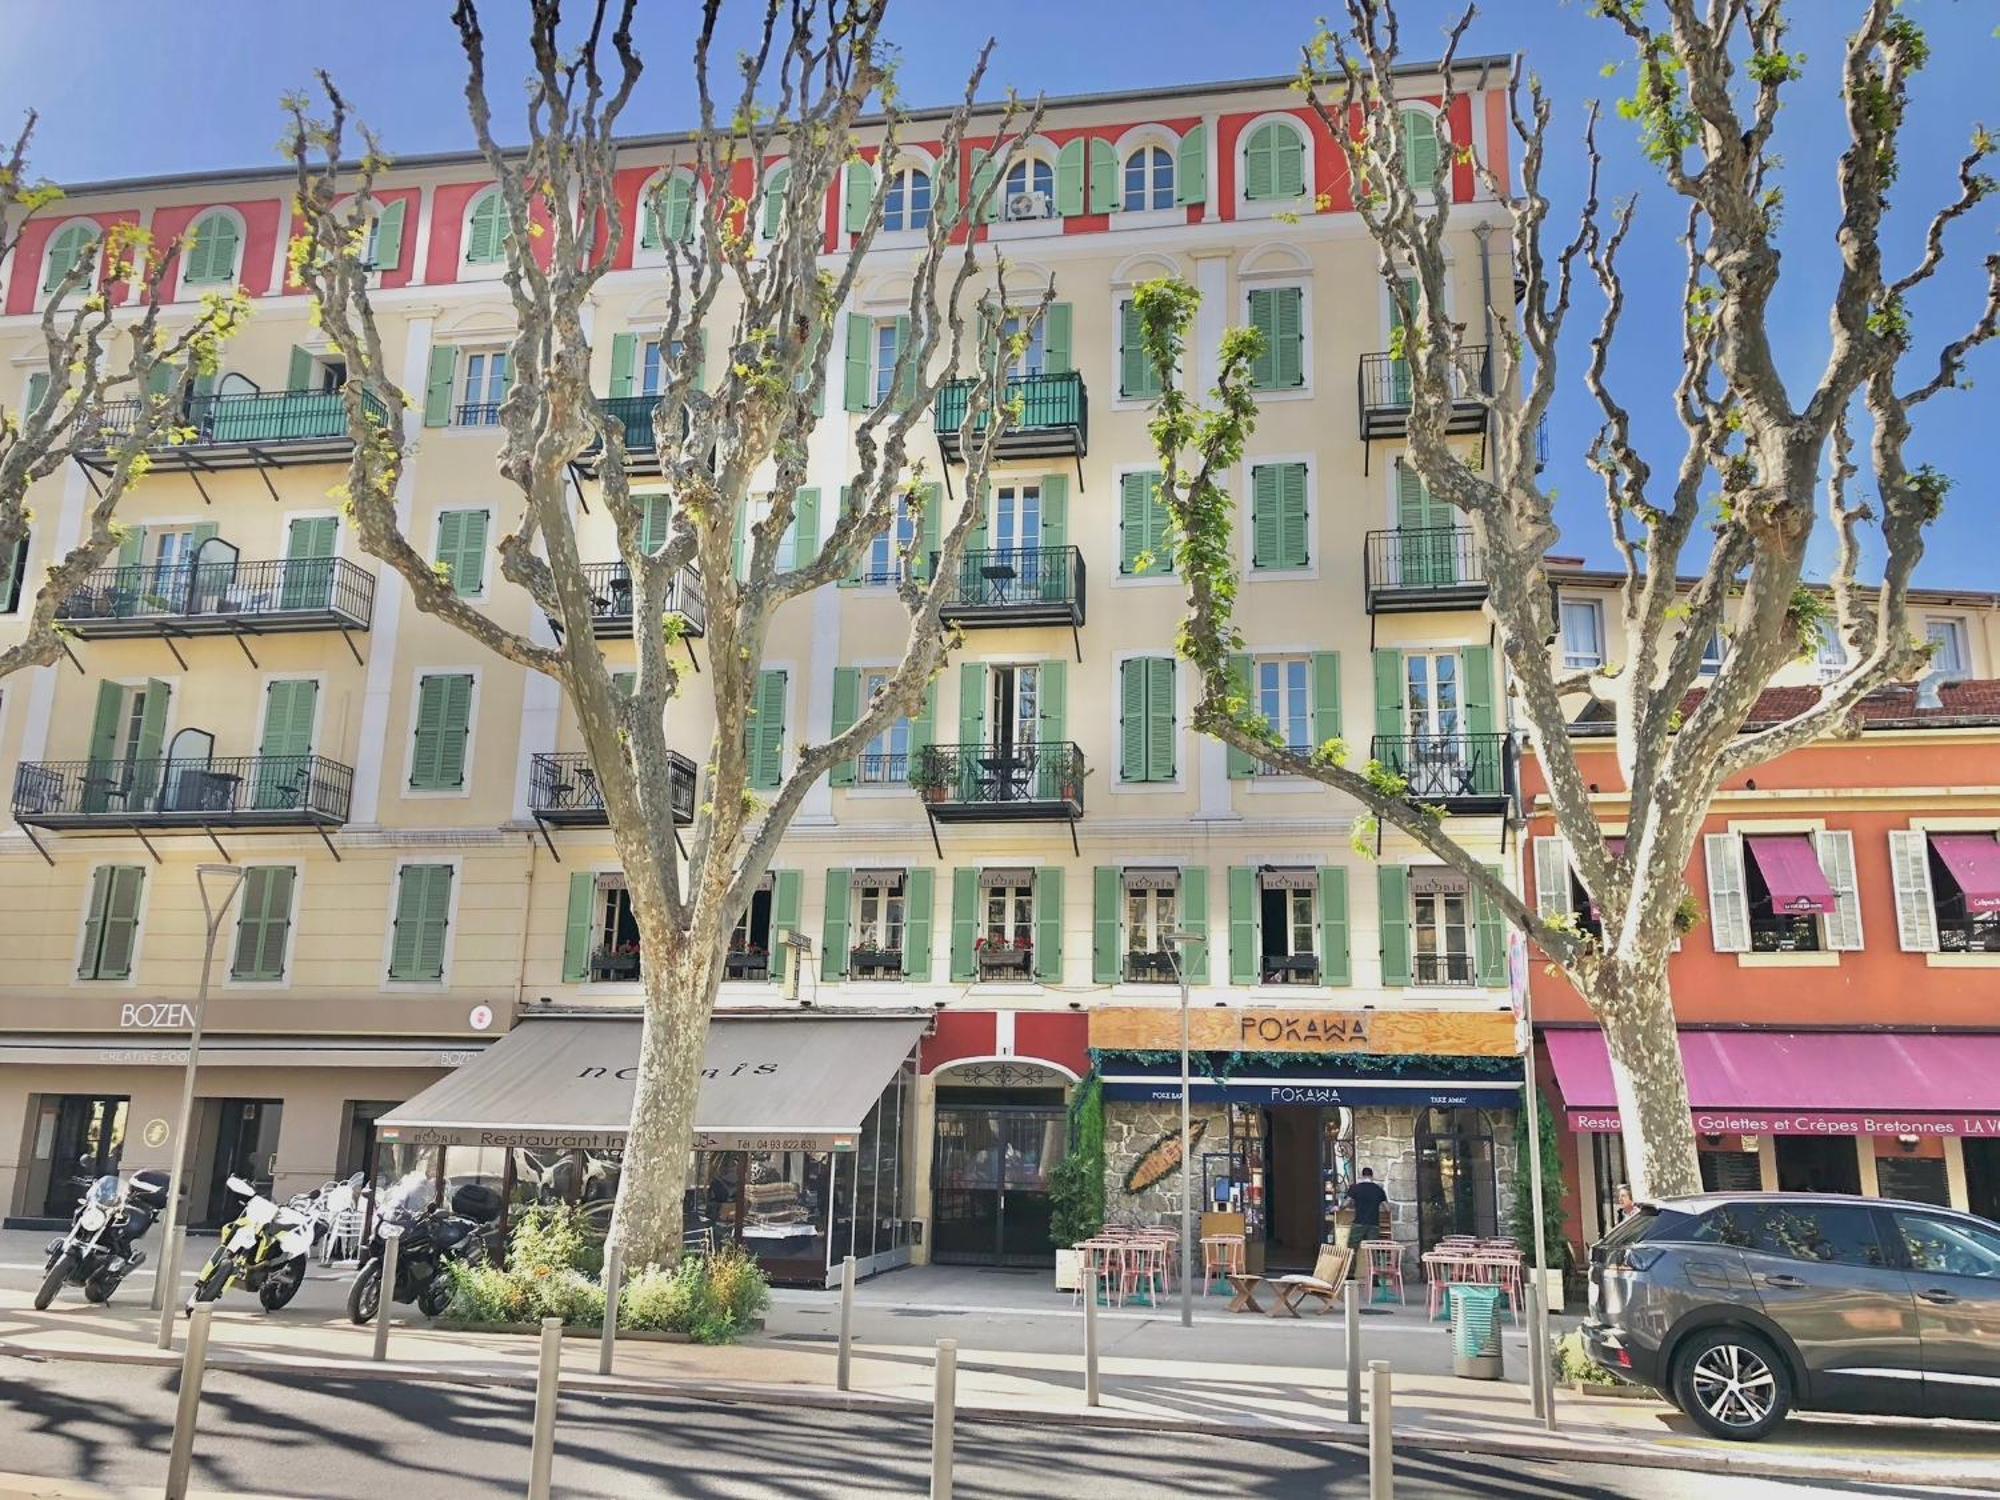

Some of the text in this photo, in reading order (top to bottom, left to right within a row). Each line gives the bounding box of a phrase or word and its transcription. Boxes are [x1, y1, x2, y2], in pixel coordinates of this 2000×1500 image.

[120, 1003, 199, 1028] BOZEN
[1241, 1017, 1367, 1042] POKAWA
[162, 1051, 190, 1063] FOO
[1271, 1087, 1341, 1102] POKAWA
[1578, 1115, 1621, 1129] Resta
[1699, 1115, 1768, 1131] Galettes
[1774, 1119, 1791, 1131] et
[1795, 1117, 1859, 1134] Crêpes
[1864, 1118, 1955, 1133] Bretonnes
[1964, 1119, 1985, 1133] LA
[480, 1131, 599, 1147] Restaurant
